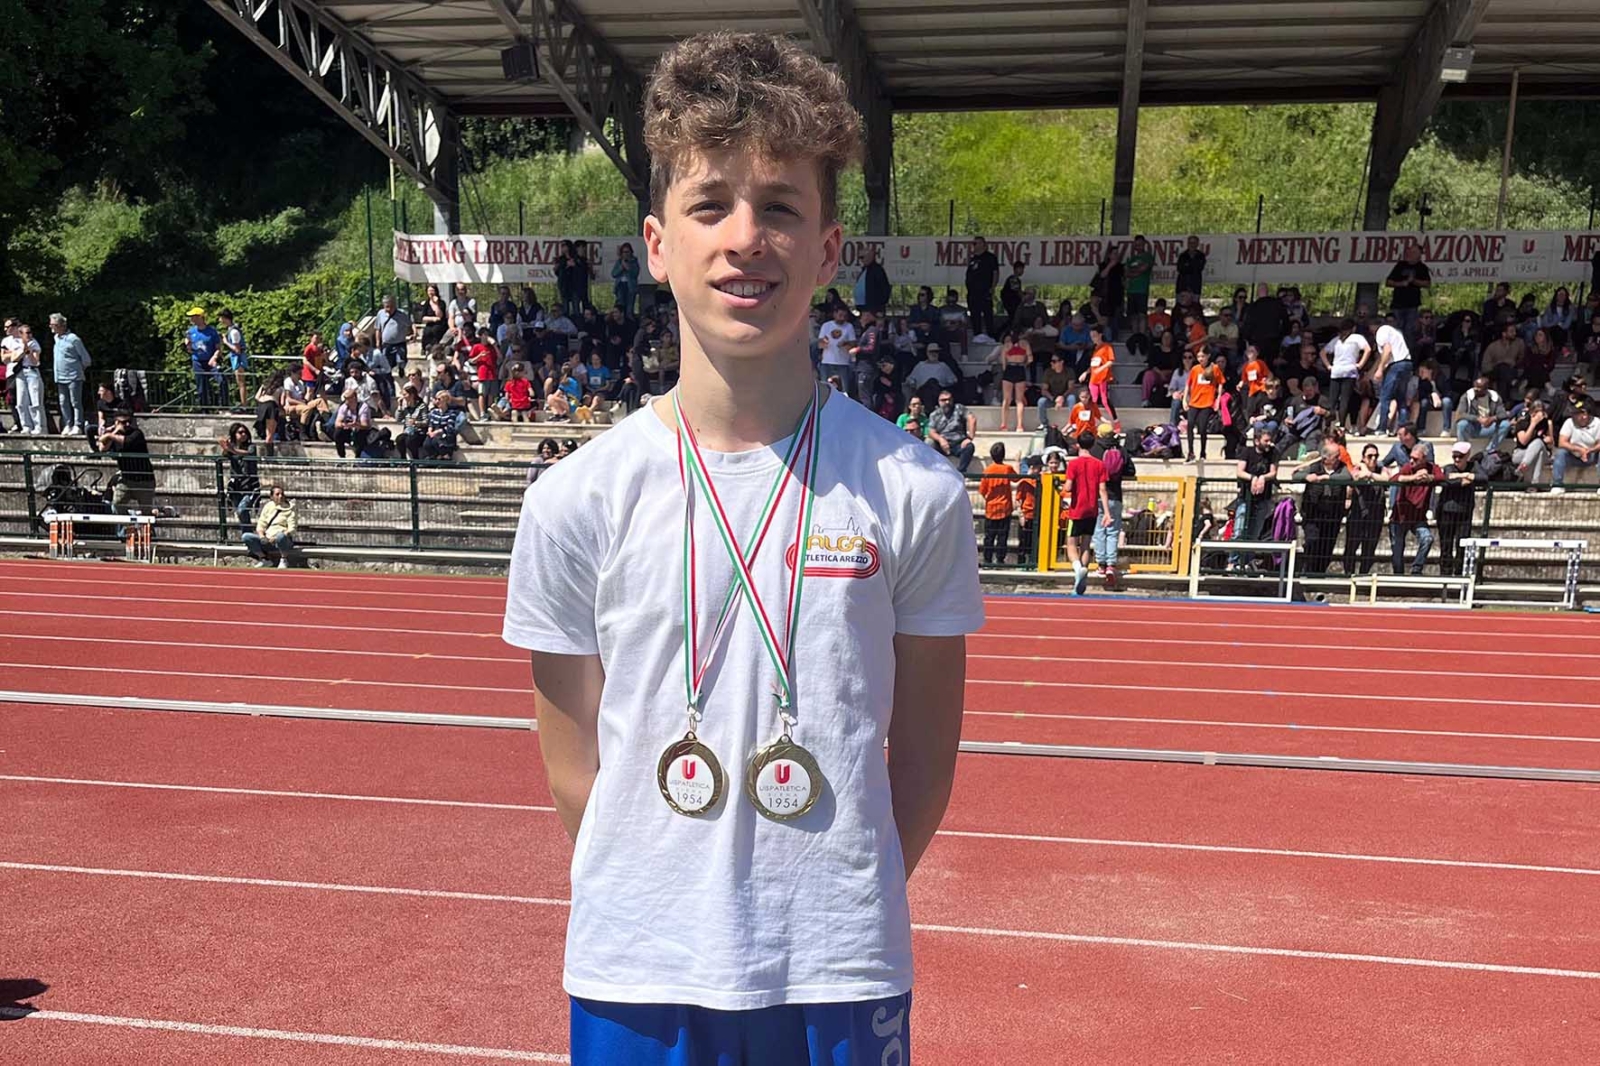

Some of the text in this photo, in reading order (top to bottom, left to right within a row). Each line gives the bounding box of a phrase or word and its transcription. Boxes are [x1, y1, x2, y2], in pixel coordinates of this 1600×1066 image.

[1236, 237, 1341, 265] MEETING
[1462, 267, 1499, 278] APRILE
[806, 534, 867, 553] ALGA
[805, 554, 869, 565] TLETICA AREZZO
[682, 759, 696, 780] U
[774, 763, 791, 785] U
[677, 792, 702, 805] 1954
[769, 797, 798, 808] 1954
